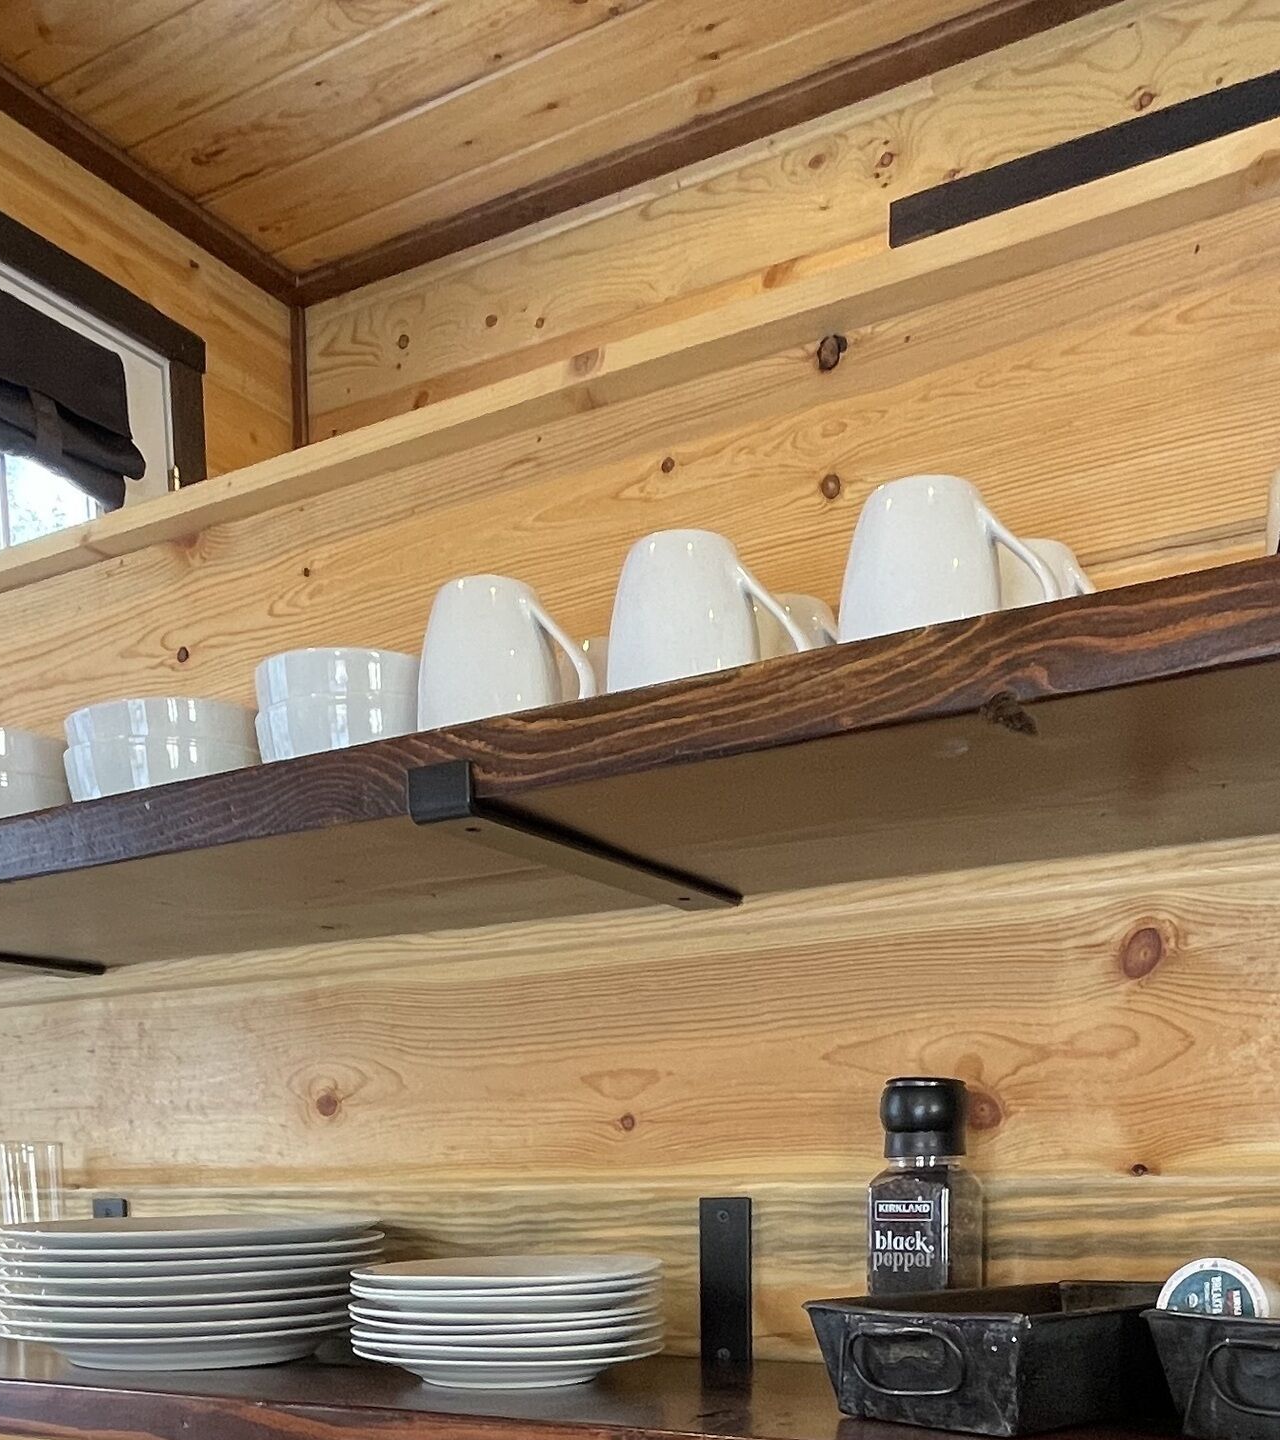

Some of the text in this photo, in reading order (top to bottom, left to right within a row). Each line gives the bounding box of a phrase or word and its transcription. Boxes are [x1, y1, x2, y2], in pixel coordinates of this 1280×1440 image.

[878, 1203, 930, 1213] KIRKLAND
[874, 1230, 934, 1253] black
[872, 1251, 935, 1272] pepper
